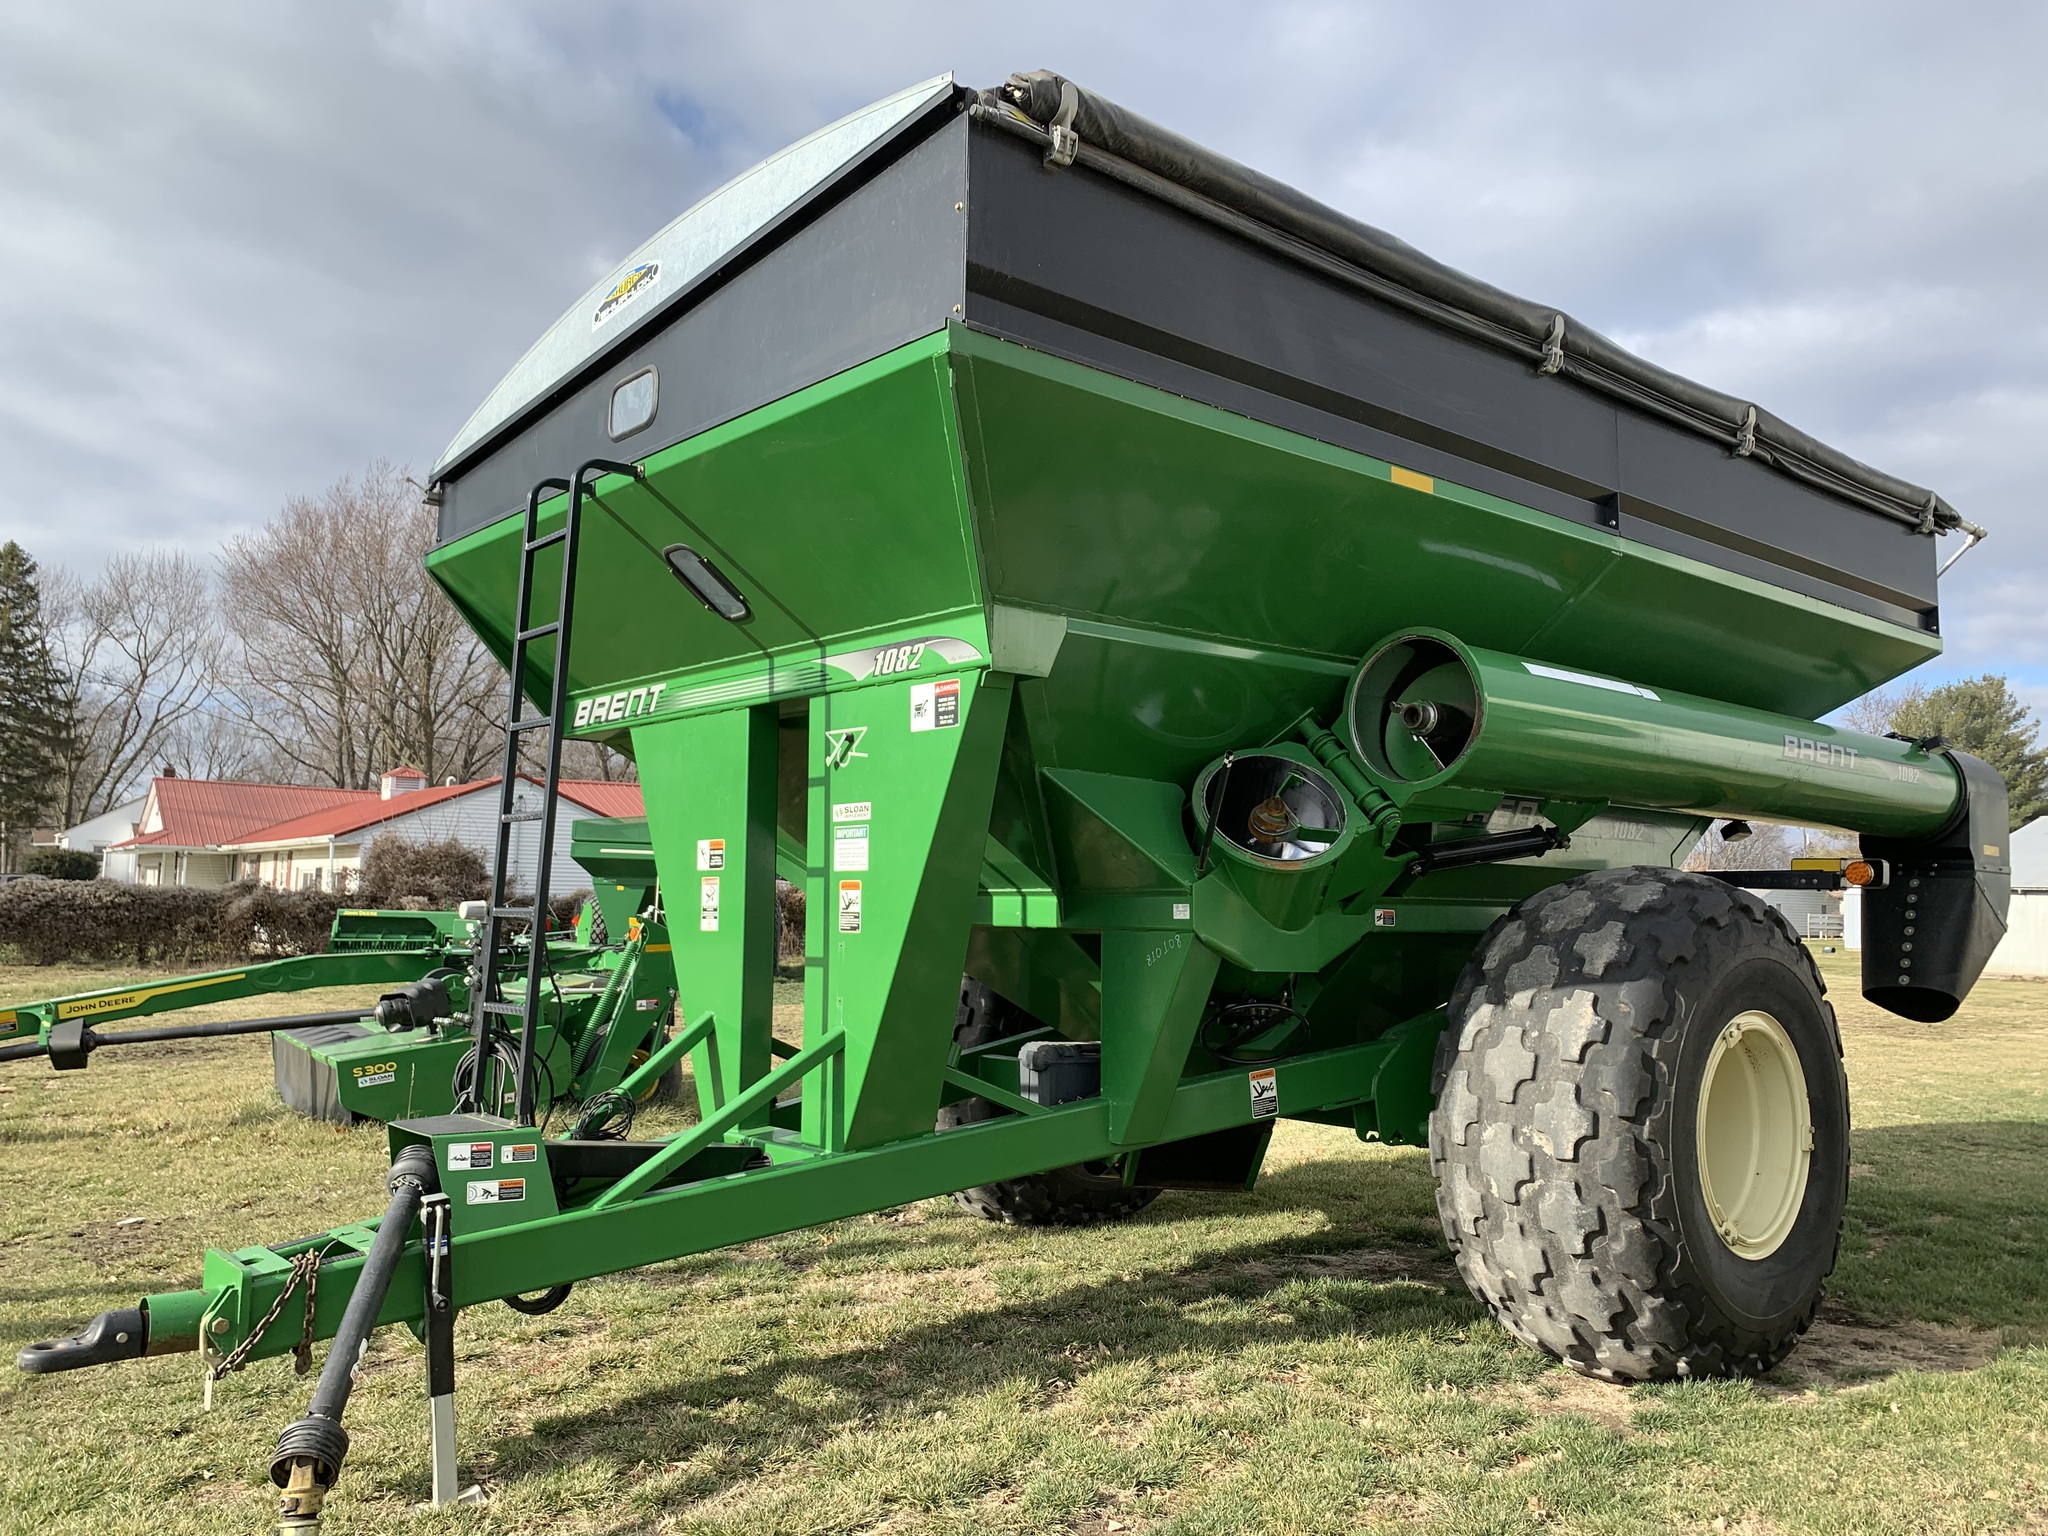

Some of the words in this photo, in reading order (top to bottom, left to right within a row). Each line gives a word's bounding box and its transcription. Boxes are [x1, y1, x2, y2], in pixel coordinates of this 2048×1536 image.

[873, 643, 926, 677] 1082
[939, 683, 959, 691] DANGER
[573, 682, 667, 728] BRENT
[1784, 735, 1859, 769] BRENT
[1898, 766, 1919, 784] 1082
[844, 805, 869, 814] SLOAN
[836, 828, 867, 838] IMPORTANT
[1614, 822, 1645, 841] 1082
[1146, 934, 1182, 967] 810108
[66, 1003, 96, 1014] JOHN
[98, 996, 136, 1008] DEERE
[364, 1061, 397, 1076] 300
